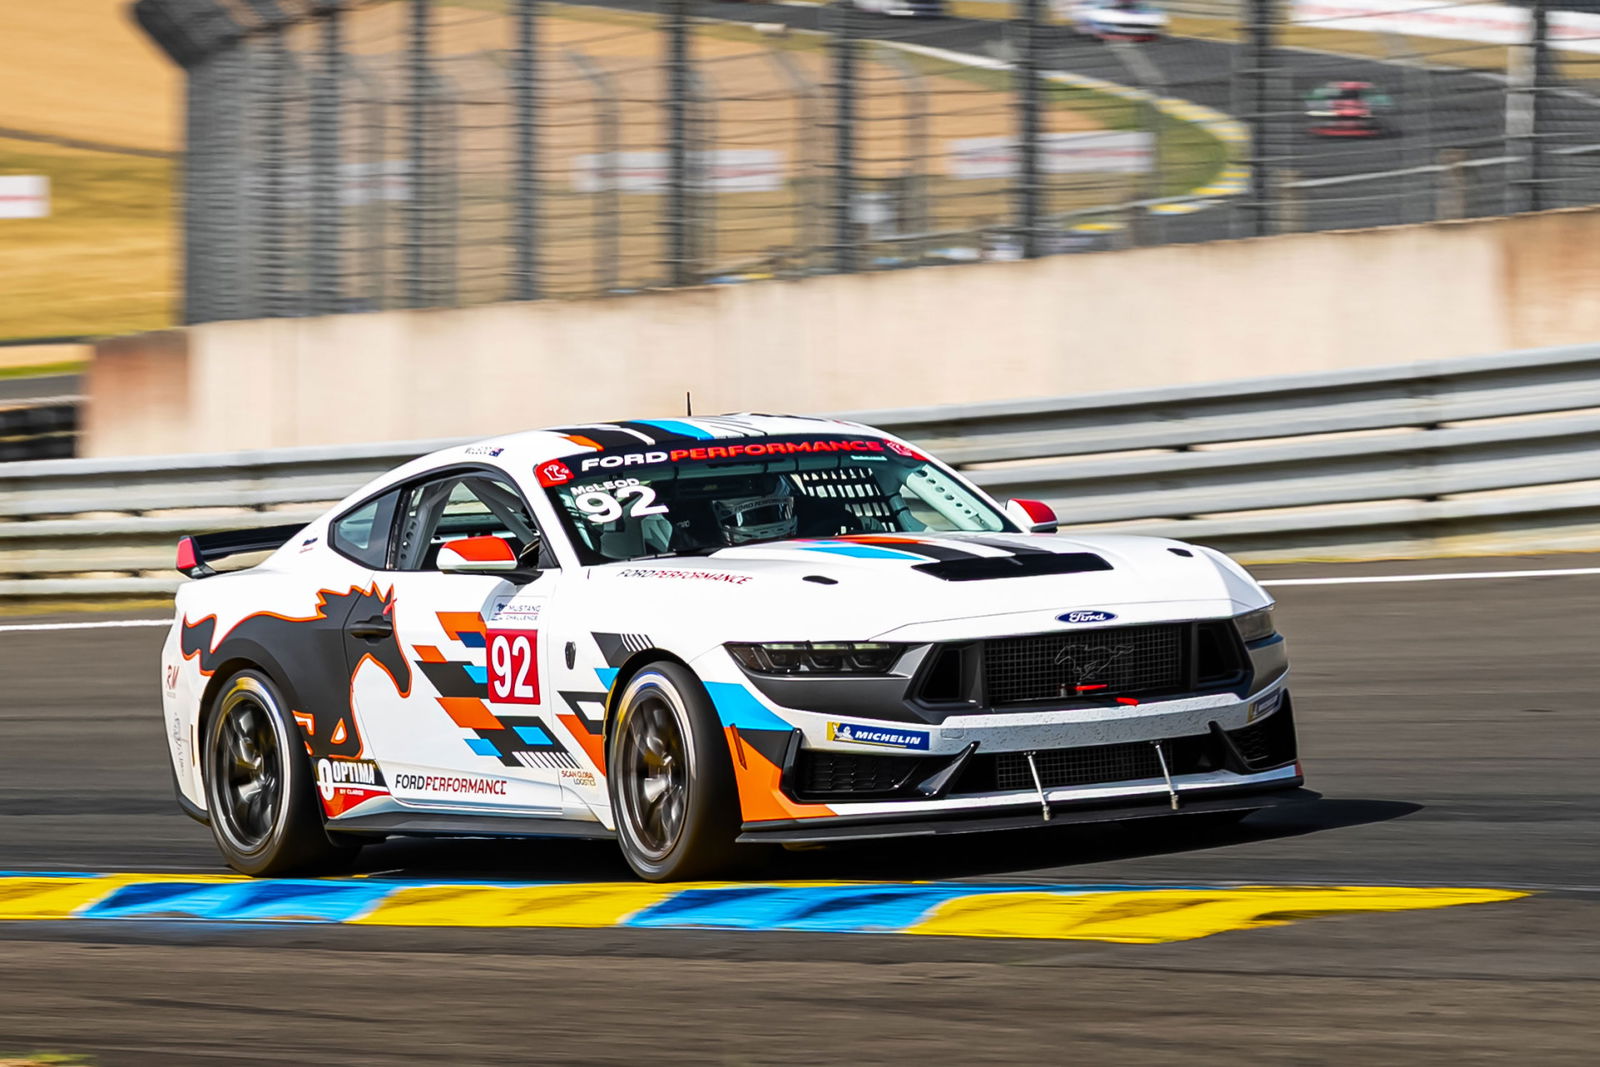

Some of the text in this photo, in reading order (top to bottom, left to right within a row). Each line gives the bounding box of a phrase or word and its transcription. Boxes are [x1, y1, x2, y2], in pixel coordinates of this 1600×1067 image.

[581, 440, 884, 472] FORDPERFORMANCE
[570, 478, 640, 496] McLEOD
[575, 485, 670, 524] 92
[508, 604, 541, 613] MUSTANG
[1068, 611, 1106, 623] Ford
[491, 635, 534, 698] 92
[854, 730, 922, 745] MICHELIN
[332, 760, 375, 785] OPTIMA
[395, 774, 507, 795] FORDPERFORMANCE
